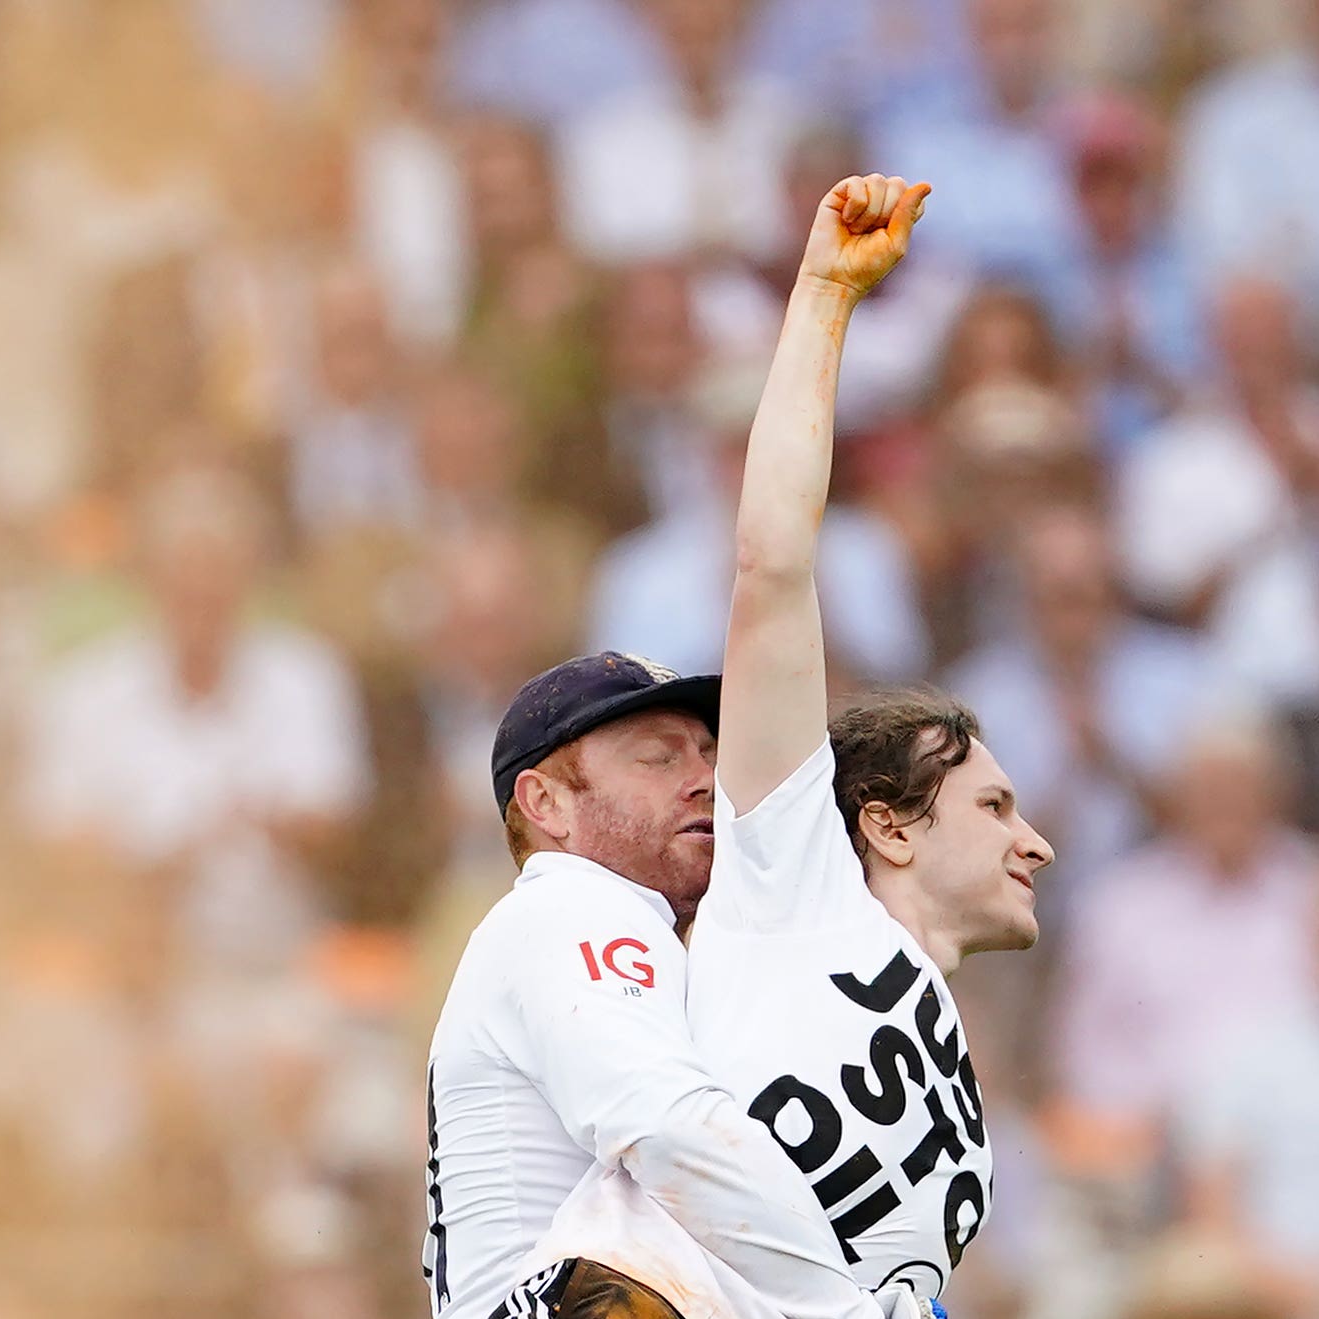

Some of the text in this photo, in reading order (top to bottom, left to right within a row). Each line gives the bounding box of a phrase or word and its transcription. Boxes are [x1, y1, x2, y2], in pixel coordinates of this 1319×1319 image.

[579, 938, 655, 988] IG
[747, 1074, 887, 1265] OIL
[829, 948, 994, 1204] JUS
[840, 1024, 985, 1268] STO
